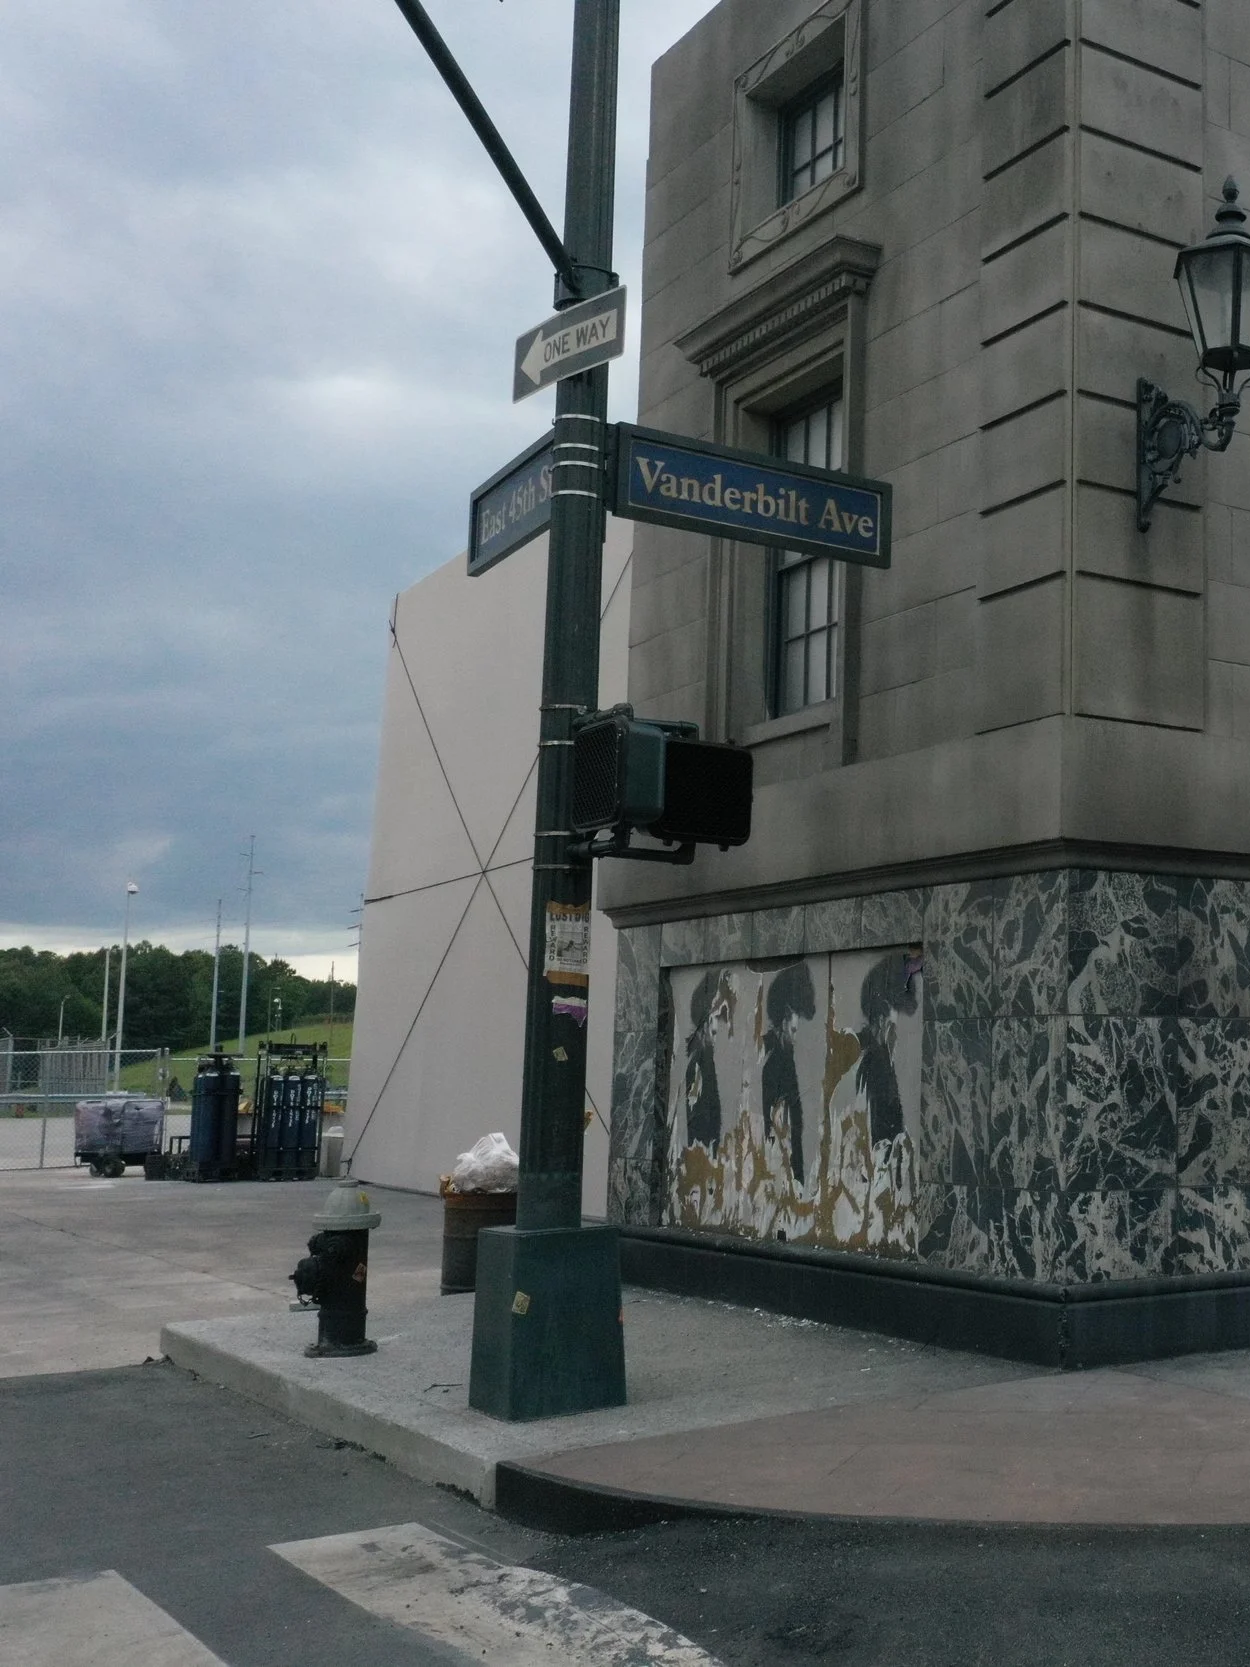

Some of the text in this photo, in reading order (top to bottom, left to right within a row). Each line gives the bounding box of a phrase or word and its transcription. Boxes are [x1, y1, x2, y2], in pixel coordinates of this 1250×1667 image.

[544, 316, 611, 362] ONE WAY
[481, 501, 506, 545] East
[508, 478, 535, 524] 45th
[636, 456, 875, 538] Vanderbilt Ave
